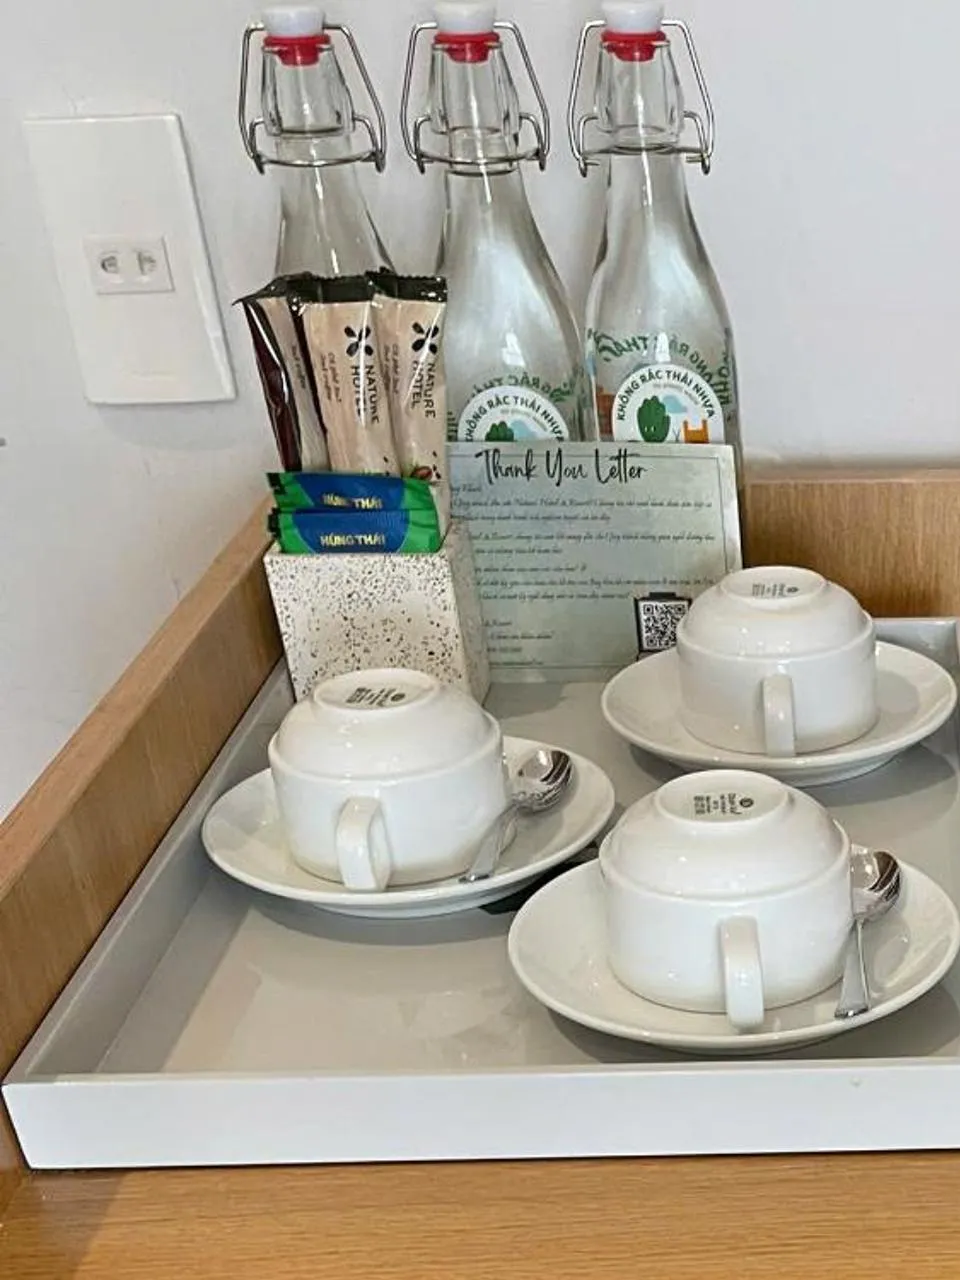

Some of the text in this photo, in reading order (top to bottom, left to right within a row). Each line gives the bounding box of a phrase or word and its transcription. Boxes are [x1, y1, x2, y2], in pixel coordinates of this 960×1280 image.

[364, 364, 380, 424] NATURE
[422, 362, 437, 419] NATURE
[616, 379, 641, 421] KHÔNG
[475, 447, 649, 487] Thank You Letter
